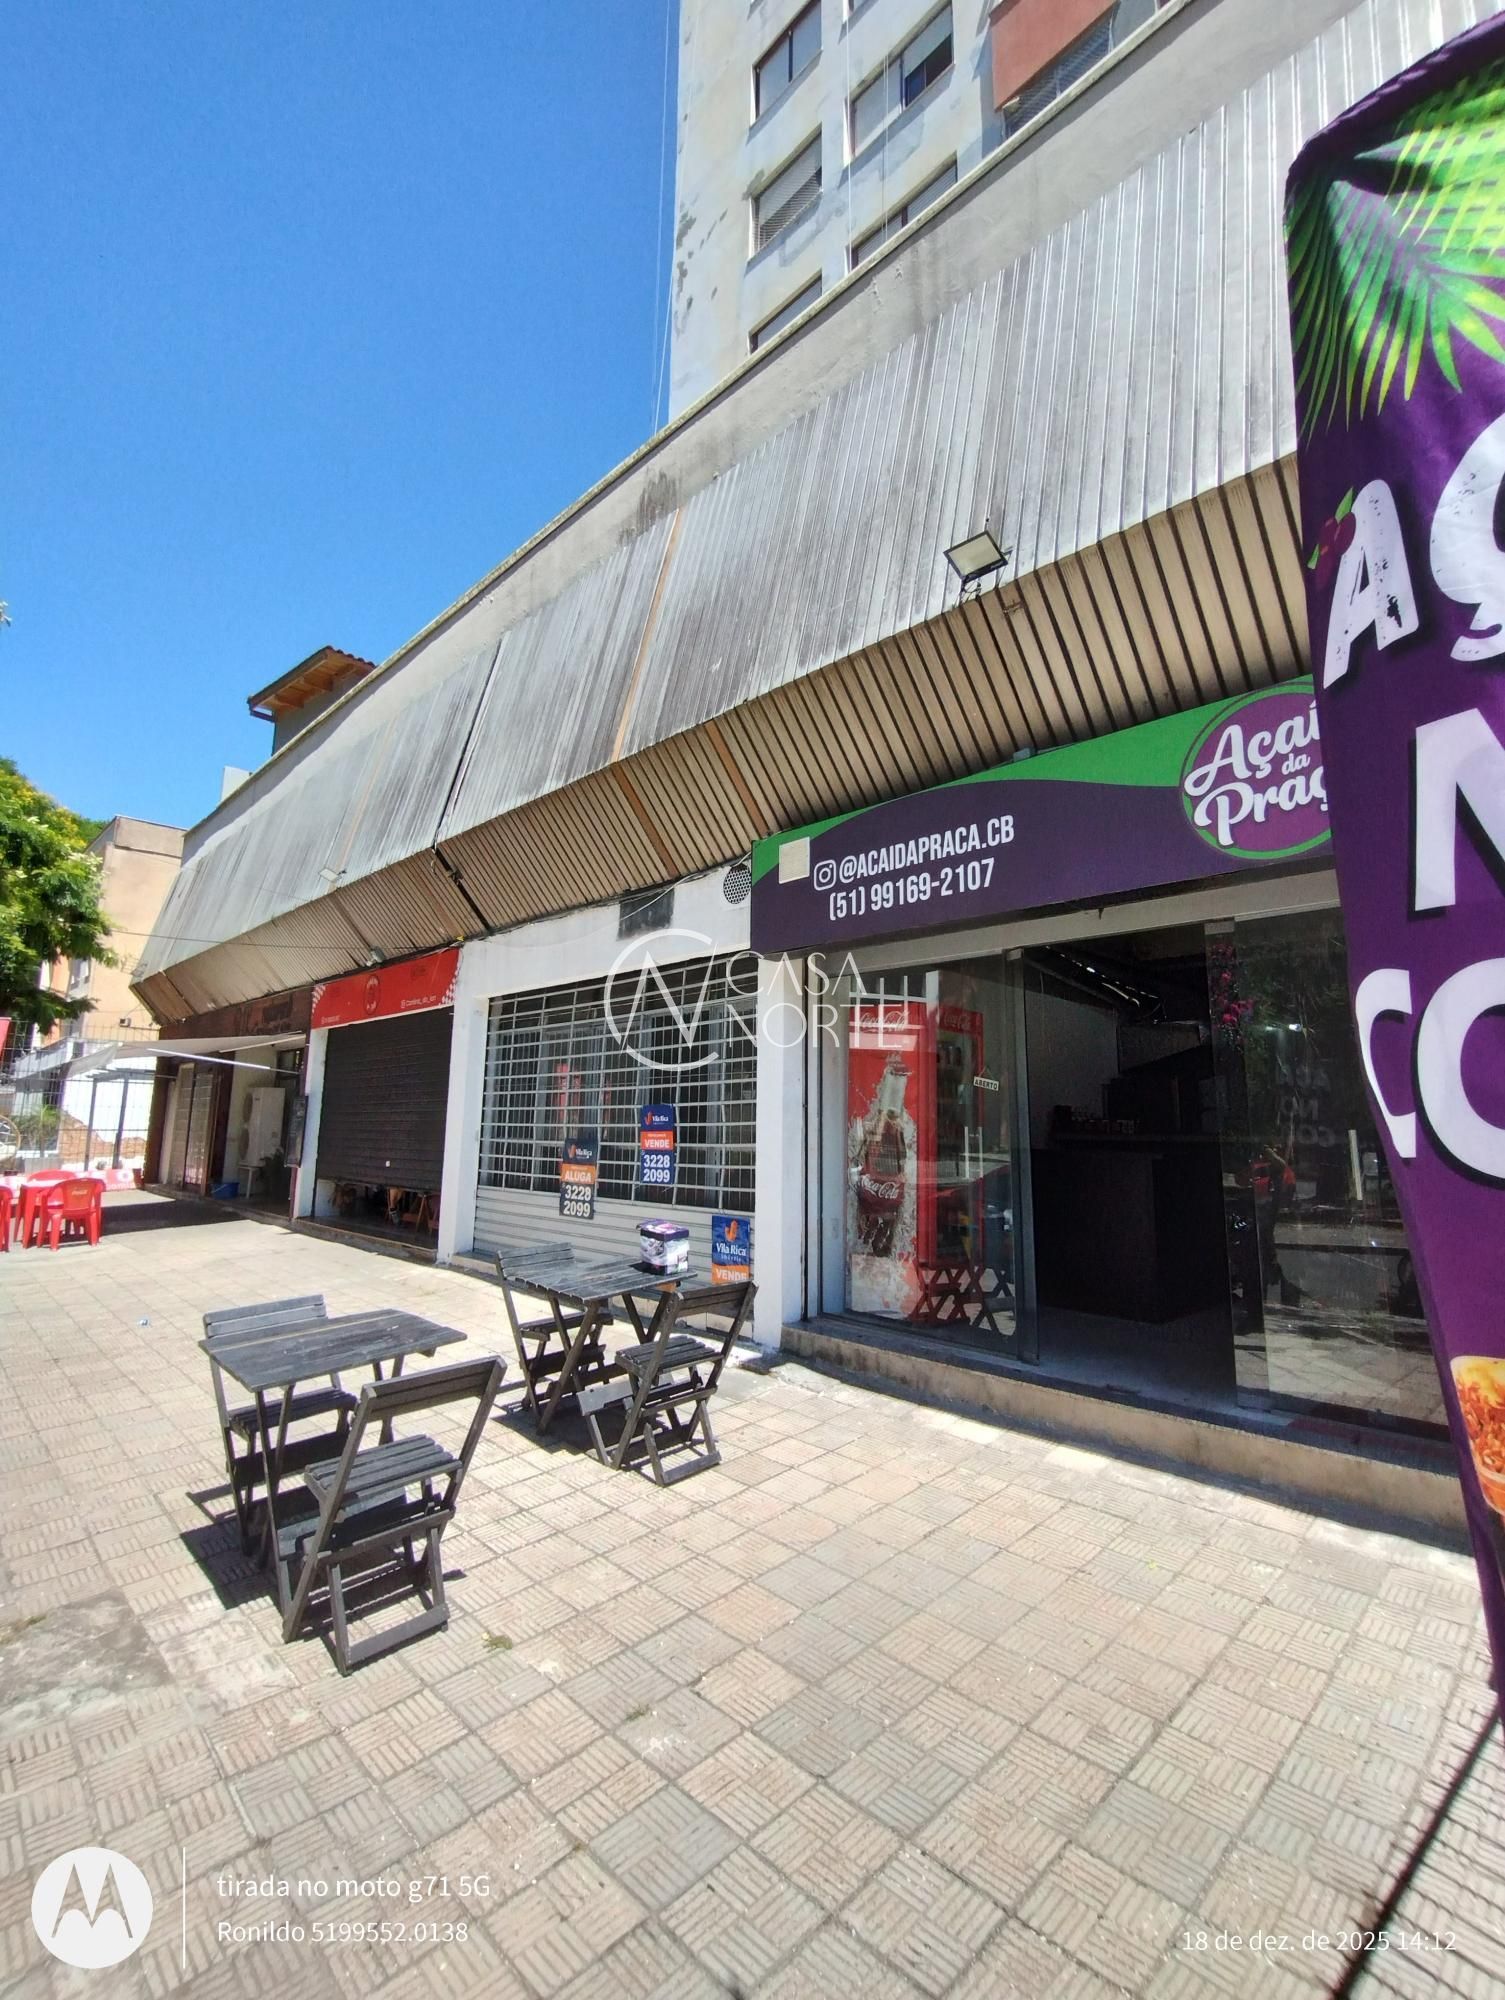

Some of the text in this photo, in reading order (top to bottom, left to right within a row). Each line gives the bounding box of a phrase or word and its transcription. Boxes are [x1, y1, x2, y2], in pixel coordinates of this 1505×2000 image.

[1281, 753, 1311, 775] da
[838, 814, 1015, 884] @ACAIDAPRACA.CB
[829, 857, 995, 921] (51) 99169-2107
[974, 1078, 998, 1090] ABERTO
[644, 1139, 670, 1148] VENDE
[643, 1154, 670, 1168] 3228
[564, 1170, 592, 1182] ALUGA
[643, 1169, 670, 1183] 2099
[564, 1184, 592, 1201] 3228
[563, 1201, 591, 1217] 2099
[716, 1242, 747, 1257] Vila Rica
[716, 1268, 748, 1281] VENDE
